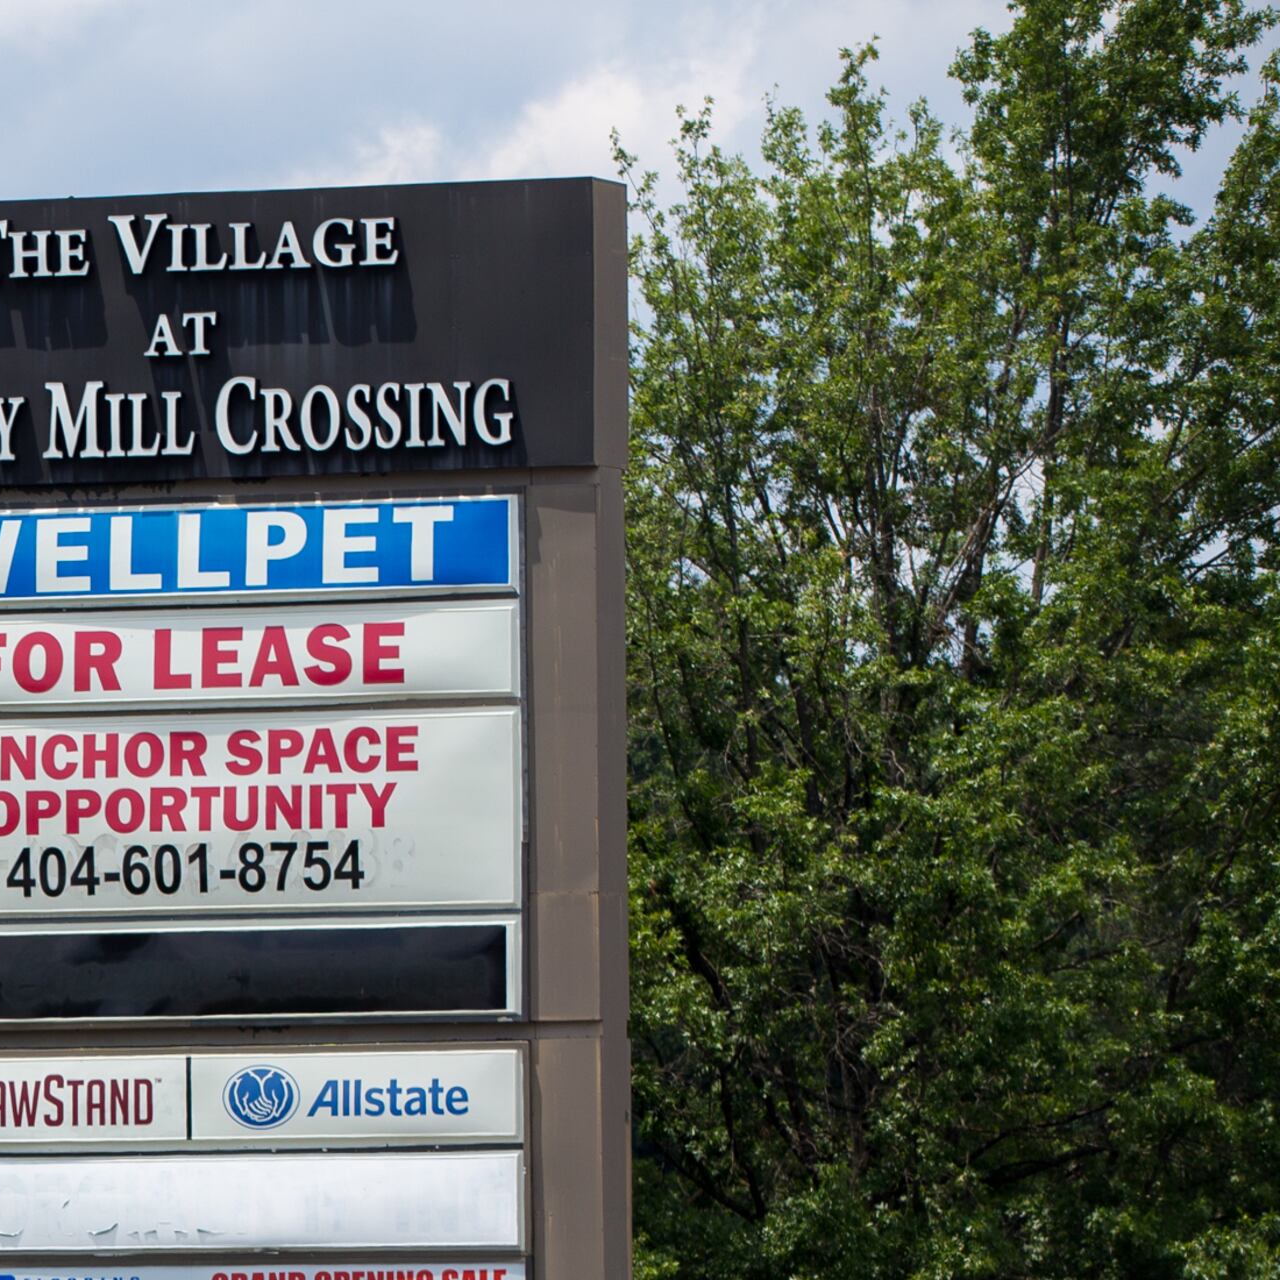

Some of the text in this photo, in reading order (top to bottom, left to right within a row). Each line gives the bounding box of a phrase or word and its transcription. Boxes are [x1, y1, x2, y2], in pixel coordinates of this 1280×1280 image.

[106, 212, 400, 276] VILLAGE
[142, 311, 218, 358] AT
[41, 380, 196, 460] MILL
[214, 375, 515, 456] CROSSING
[152, 620, 406, 691] LEASE
[224, 724, 420, 777] SPACE
[5, 838, 366, 899] 404-601-8754
[306, 1078, 470, 1117] Allstate
